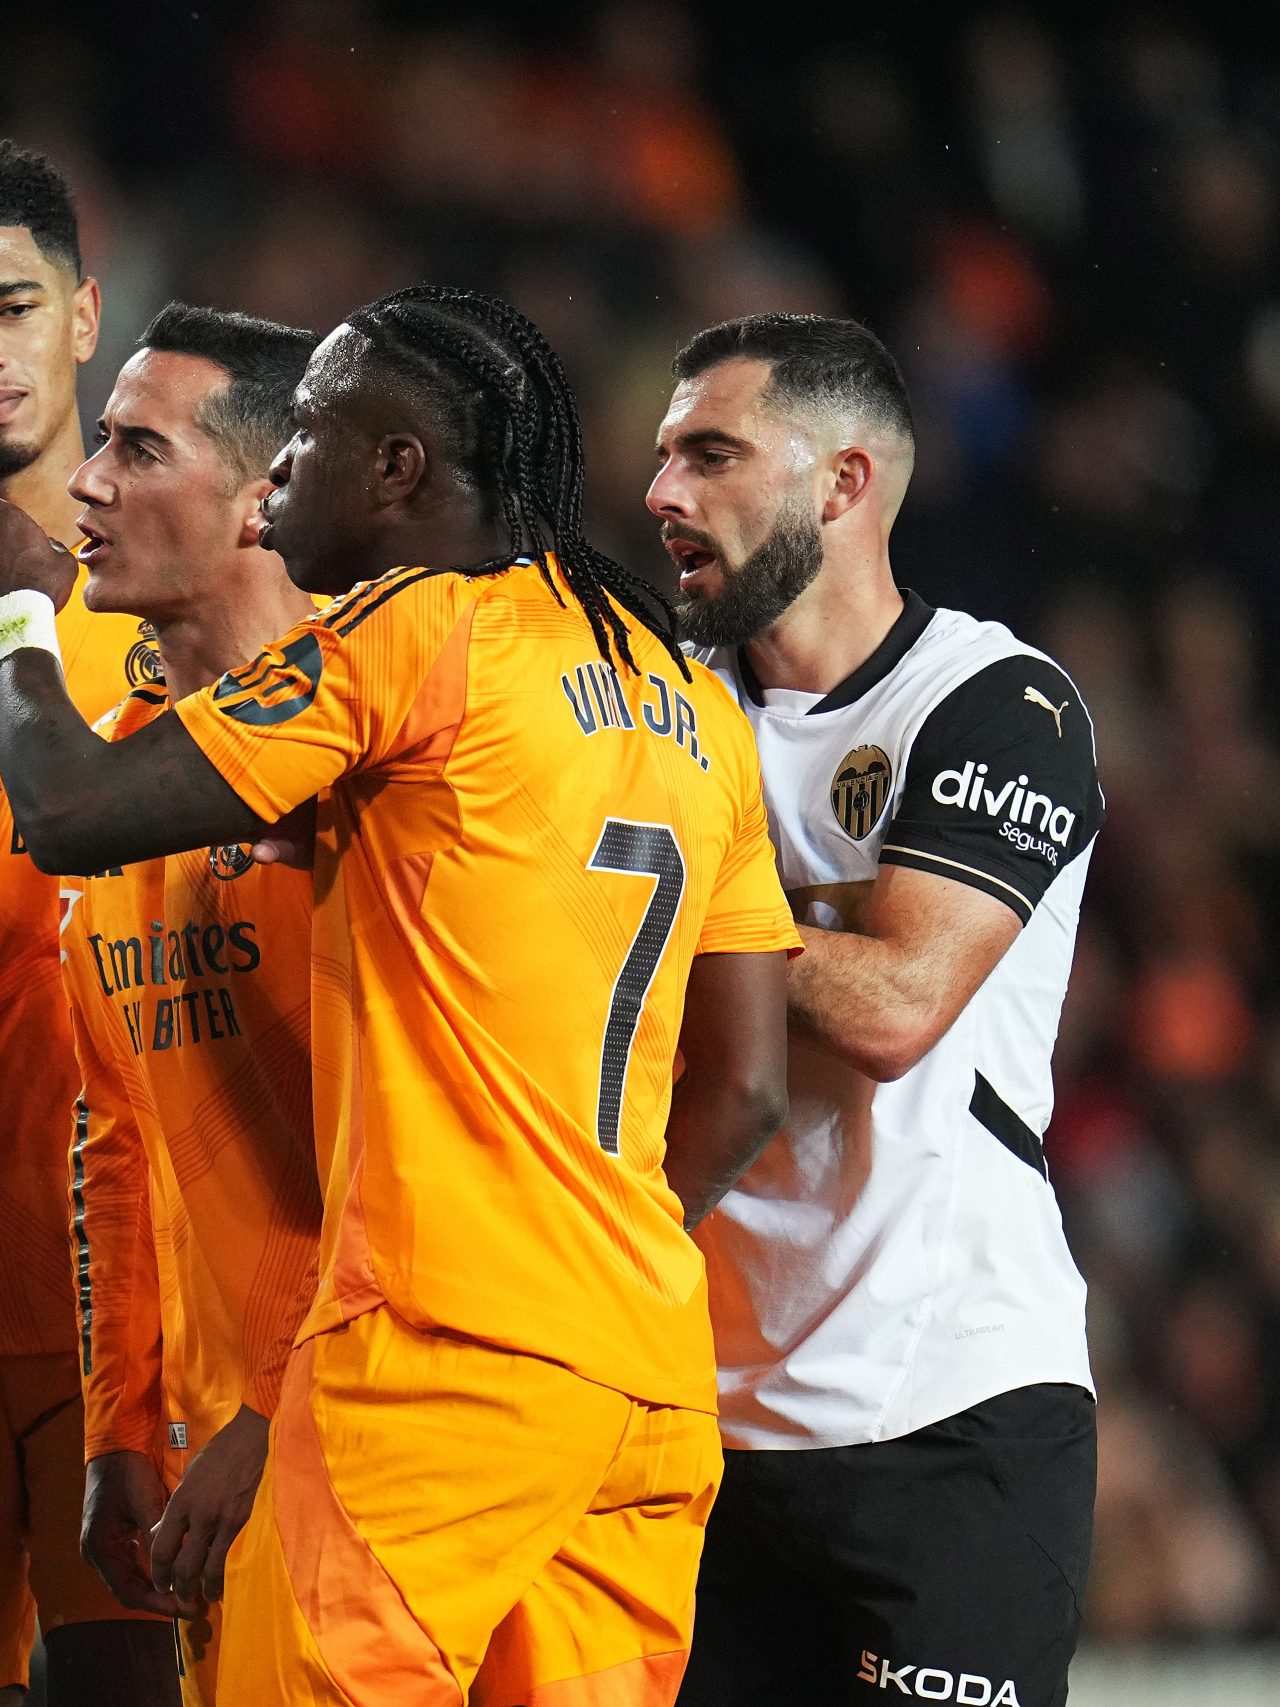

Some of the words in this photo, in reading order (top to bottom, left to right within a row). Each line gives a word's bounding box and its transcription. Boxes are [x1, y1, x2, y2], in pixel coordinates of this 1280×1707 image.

[560, 660, 637, 737] VIN
[641, 671, 711, 773] JR.
[931, 760, 1076, 848] divina
[998, 821, 1059, 867] seguros
[585, 815, 688, 1159] 7
